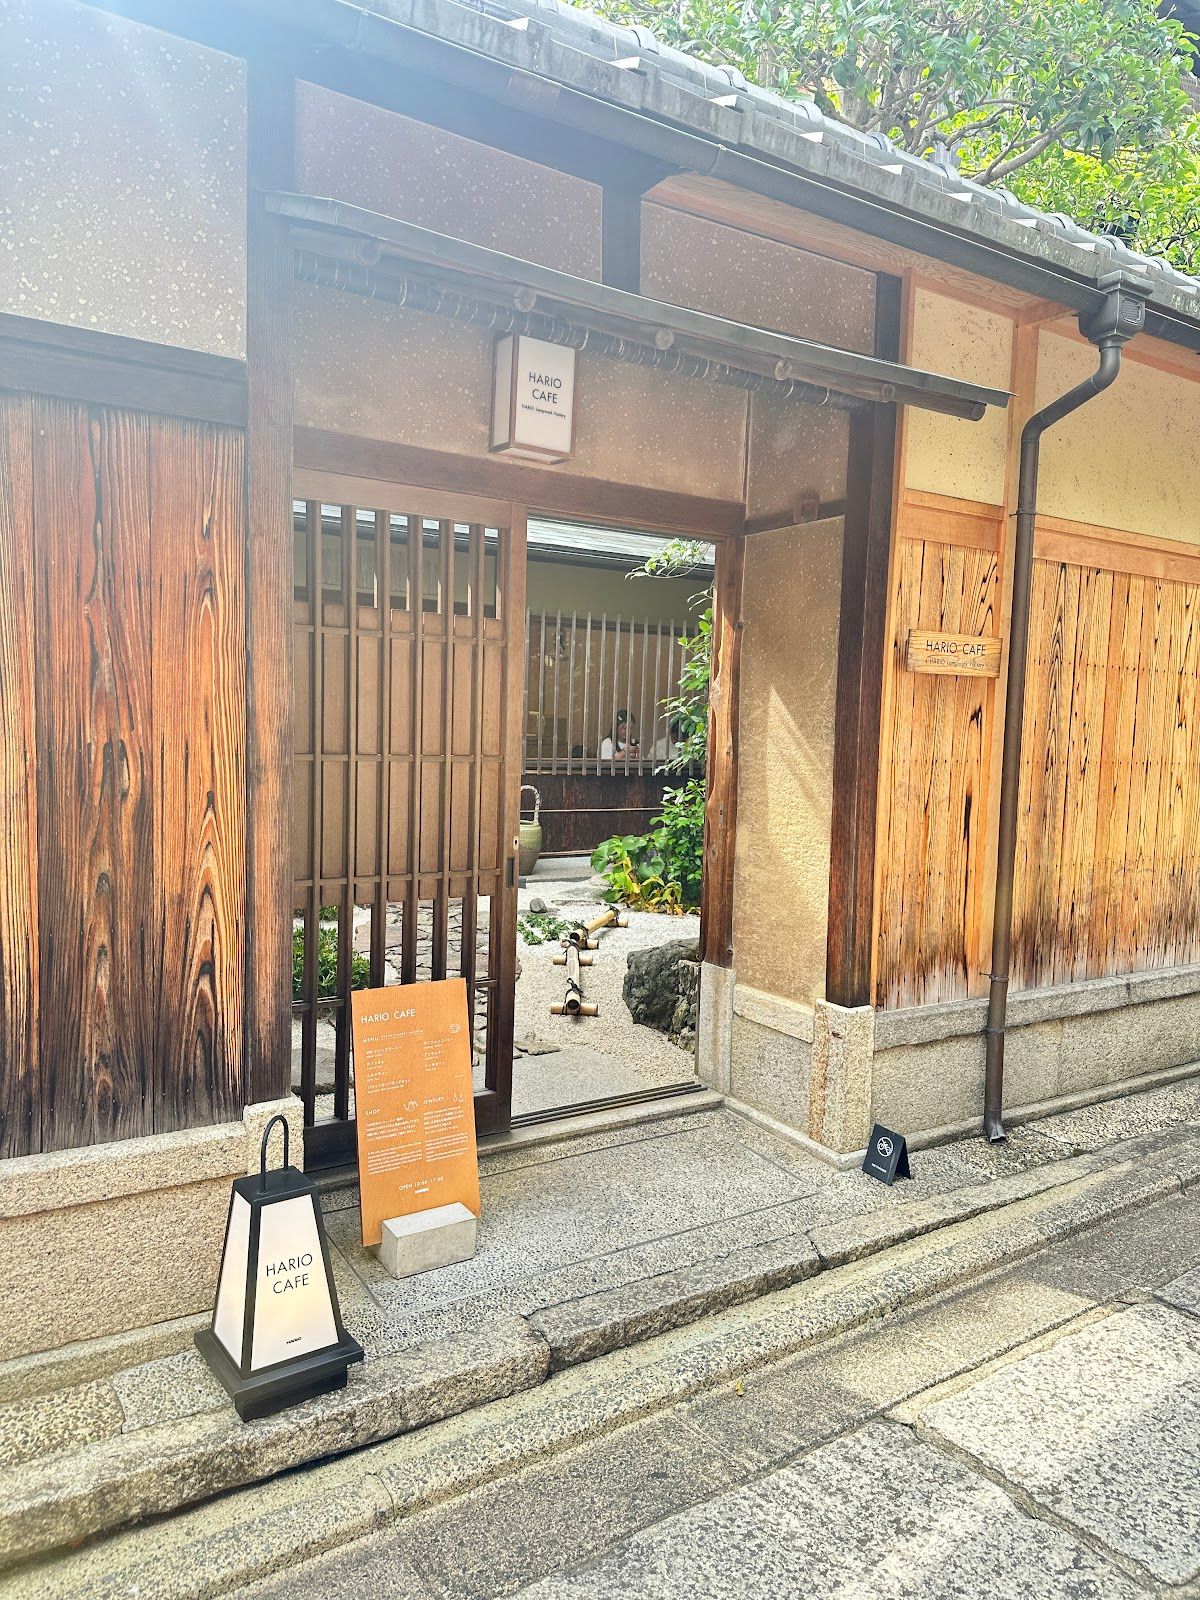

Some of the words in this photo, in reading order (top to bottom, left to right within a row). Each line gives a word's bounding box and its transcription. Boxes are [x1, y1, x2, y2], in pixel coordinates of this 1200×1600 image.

[529, 371, 562, 389] HARIO
[532, 388, 558, 404] CAFE
[926, 640, 958, 654] HARIO
[962, 643, 986, 656] CAFE
[361, 1012, 390, 1024] HARIO
[393, 1008, 417, 1020] CAFE
[365, 1108, 381, 1117] SHOP
[398, 1183, 413, 1191] OPEN
[266, 1253, 313, 1277] HARIO
[273, 1273, 310, 1294] CAFE
